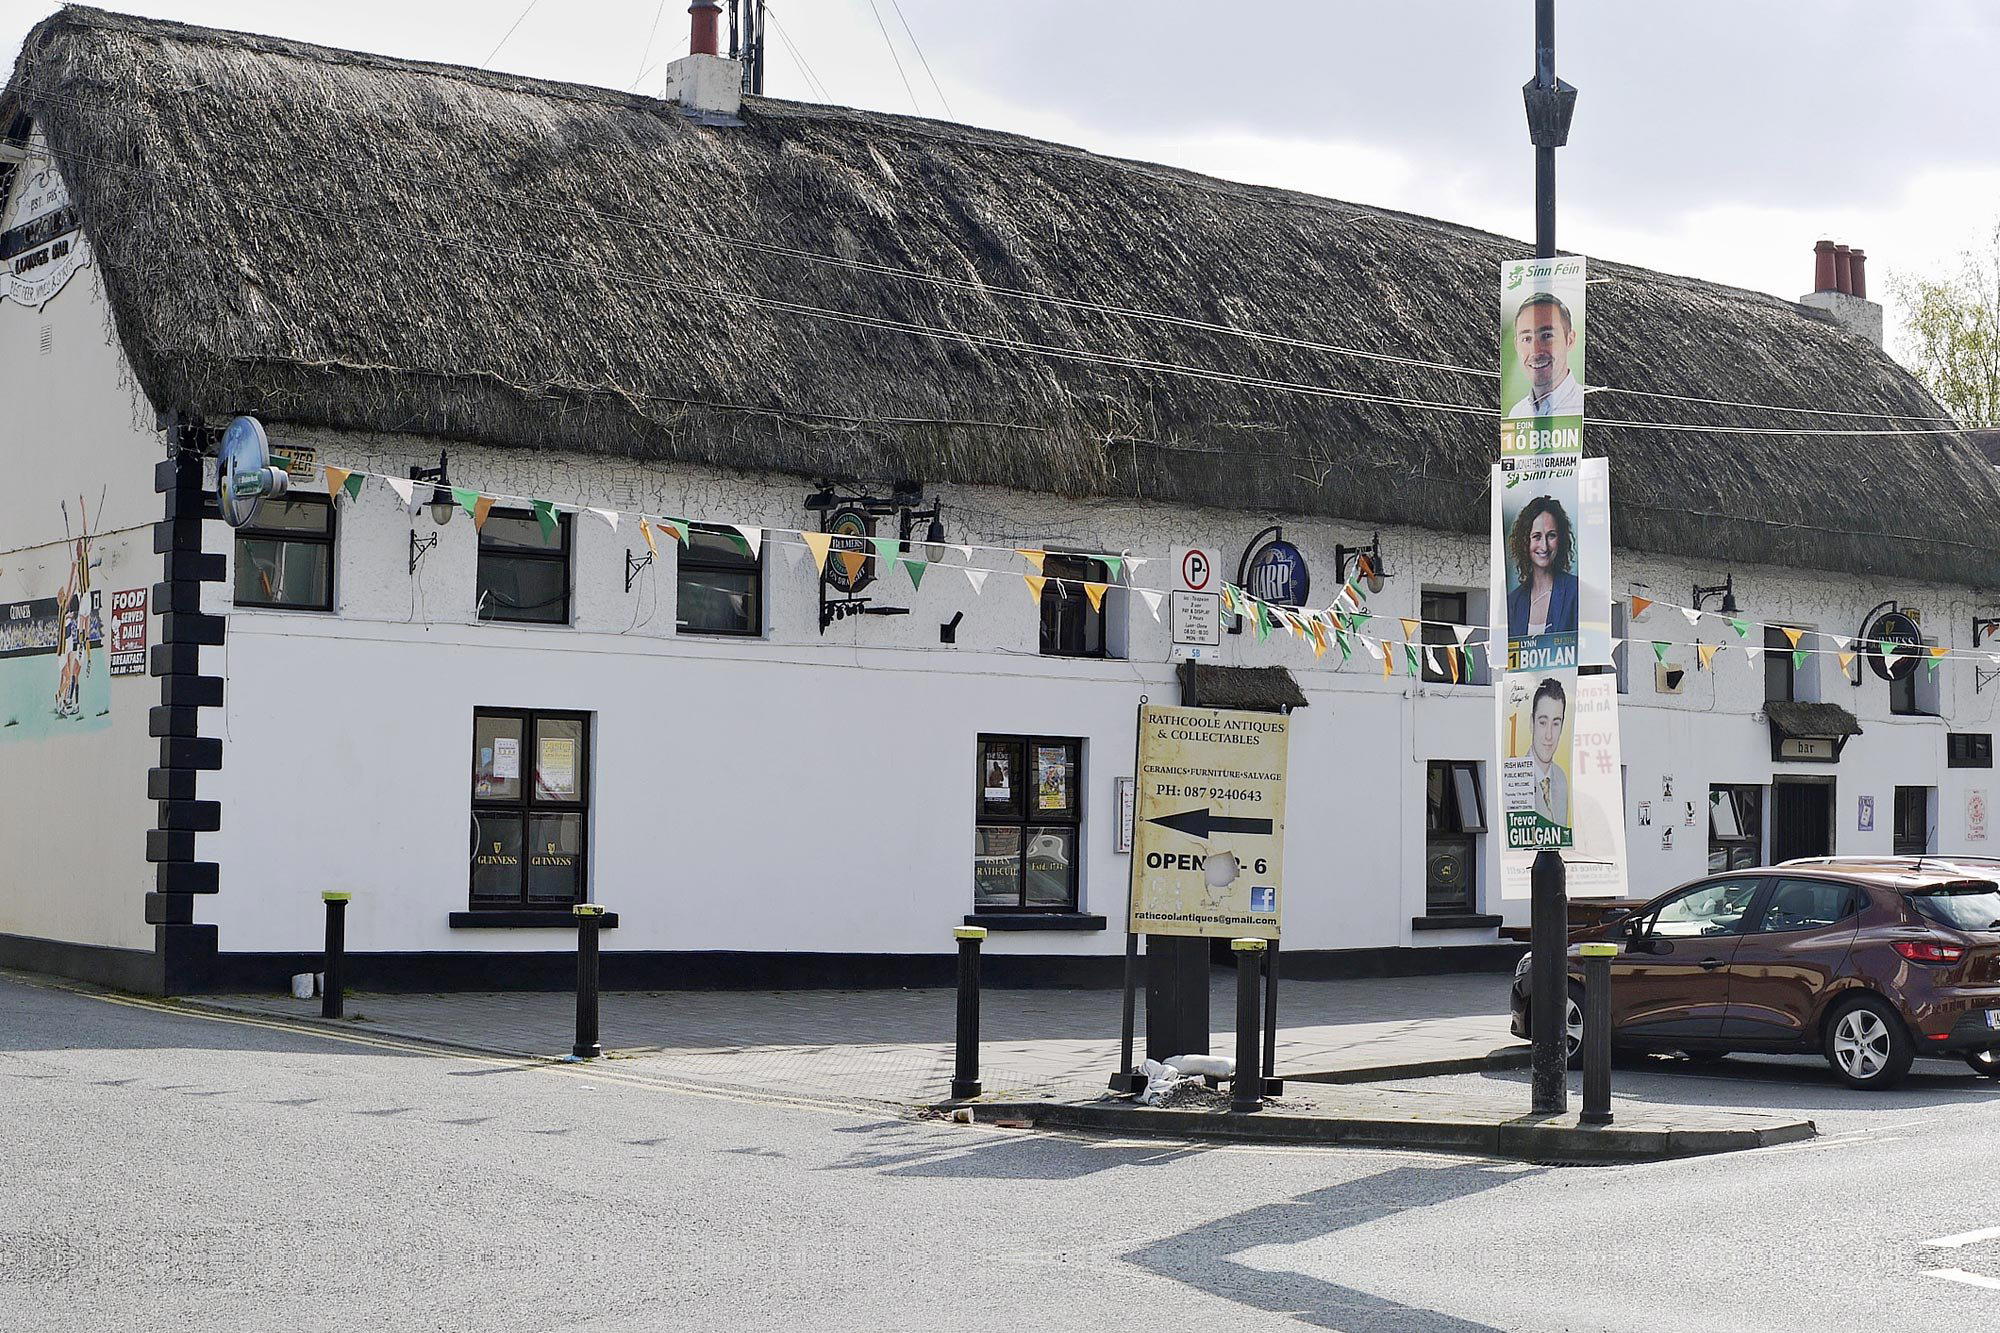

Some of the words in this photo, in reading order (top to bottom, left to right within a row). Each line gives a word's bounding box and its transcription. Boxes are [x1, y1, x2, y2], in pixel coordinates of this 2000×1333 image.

[1526, 265, 1551, 277] Sinn
[1554, 263, 1580, 276] Féin
[1516, 421, 1534, 430] EOIN
[1503, 433, 1512, 449] 1
[1529, 428, 1579, 450] BROIN
[1544, 456, 1577, 468] GRAHAM
[832, 539, 863, 548] BULMERS
[1191, 557, 1203, 582] P
[1252, 563, 1290, 600] HARP
[113, 590, 146, 610] FOOD
[121, 610, 144, 623] SERVED
[123, 624, 144, 639] DAILY
[1520, 640, 1537, 648] LYNN
[1509, 653, 1517, 668] 1
[1520, 646, 1575, 669] BOYLAN
[1149, 714, 1221, 729] RATHCOOLE
[1224, 720, 1285, 733] ANTIQUES
[1157, 729, 1168, 739] &
[1171, 730, 1260, 745] COLLECTABLES
[1509, 713, 1517, 758] 1
[1798, 741, 1814, 753] bar
[1157, 784, 1180, 796] PH:
[1184, 786, 1206, 798] 087
[1209, 788, 1262, 801] 9240643
[1509, 813, 1537, 826] Trevor
[1510, 827, 1560, 845] GILLIGAN
[478, 855, 517, 864] GUINNESS
[532, 857, 571, 866] GUINNESS
[1146, 852, 1207, 871] OPEN
[1254, 858, 1267, 874] 6
